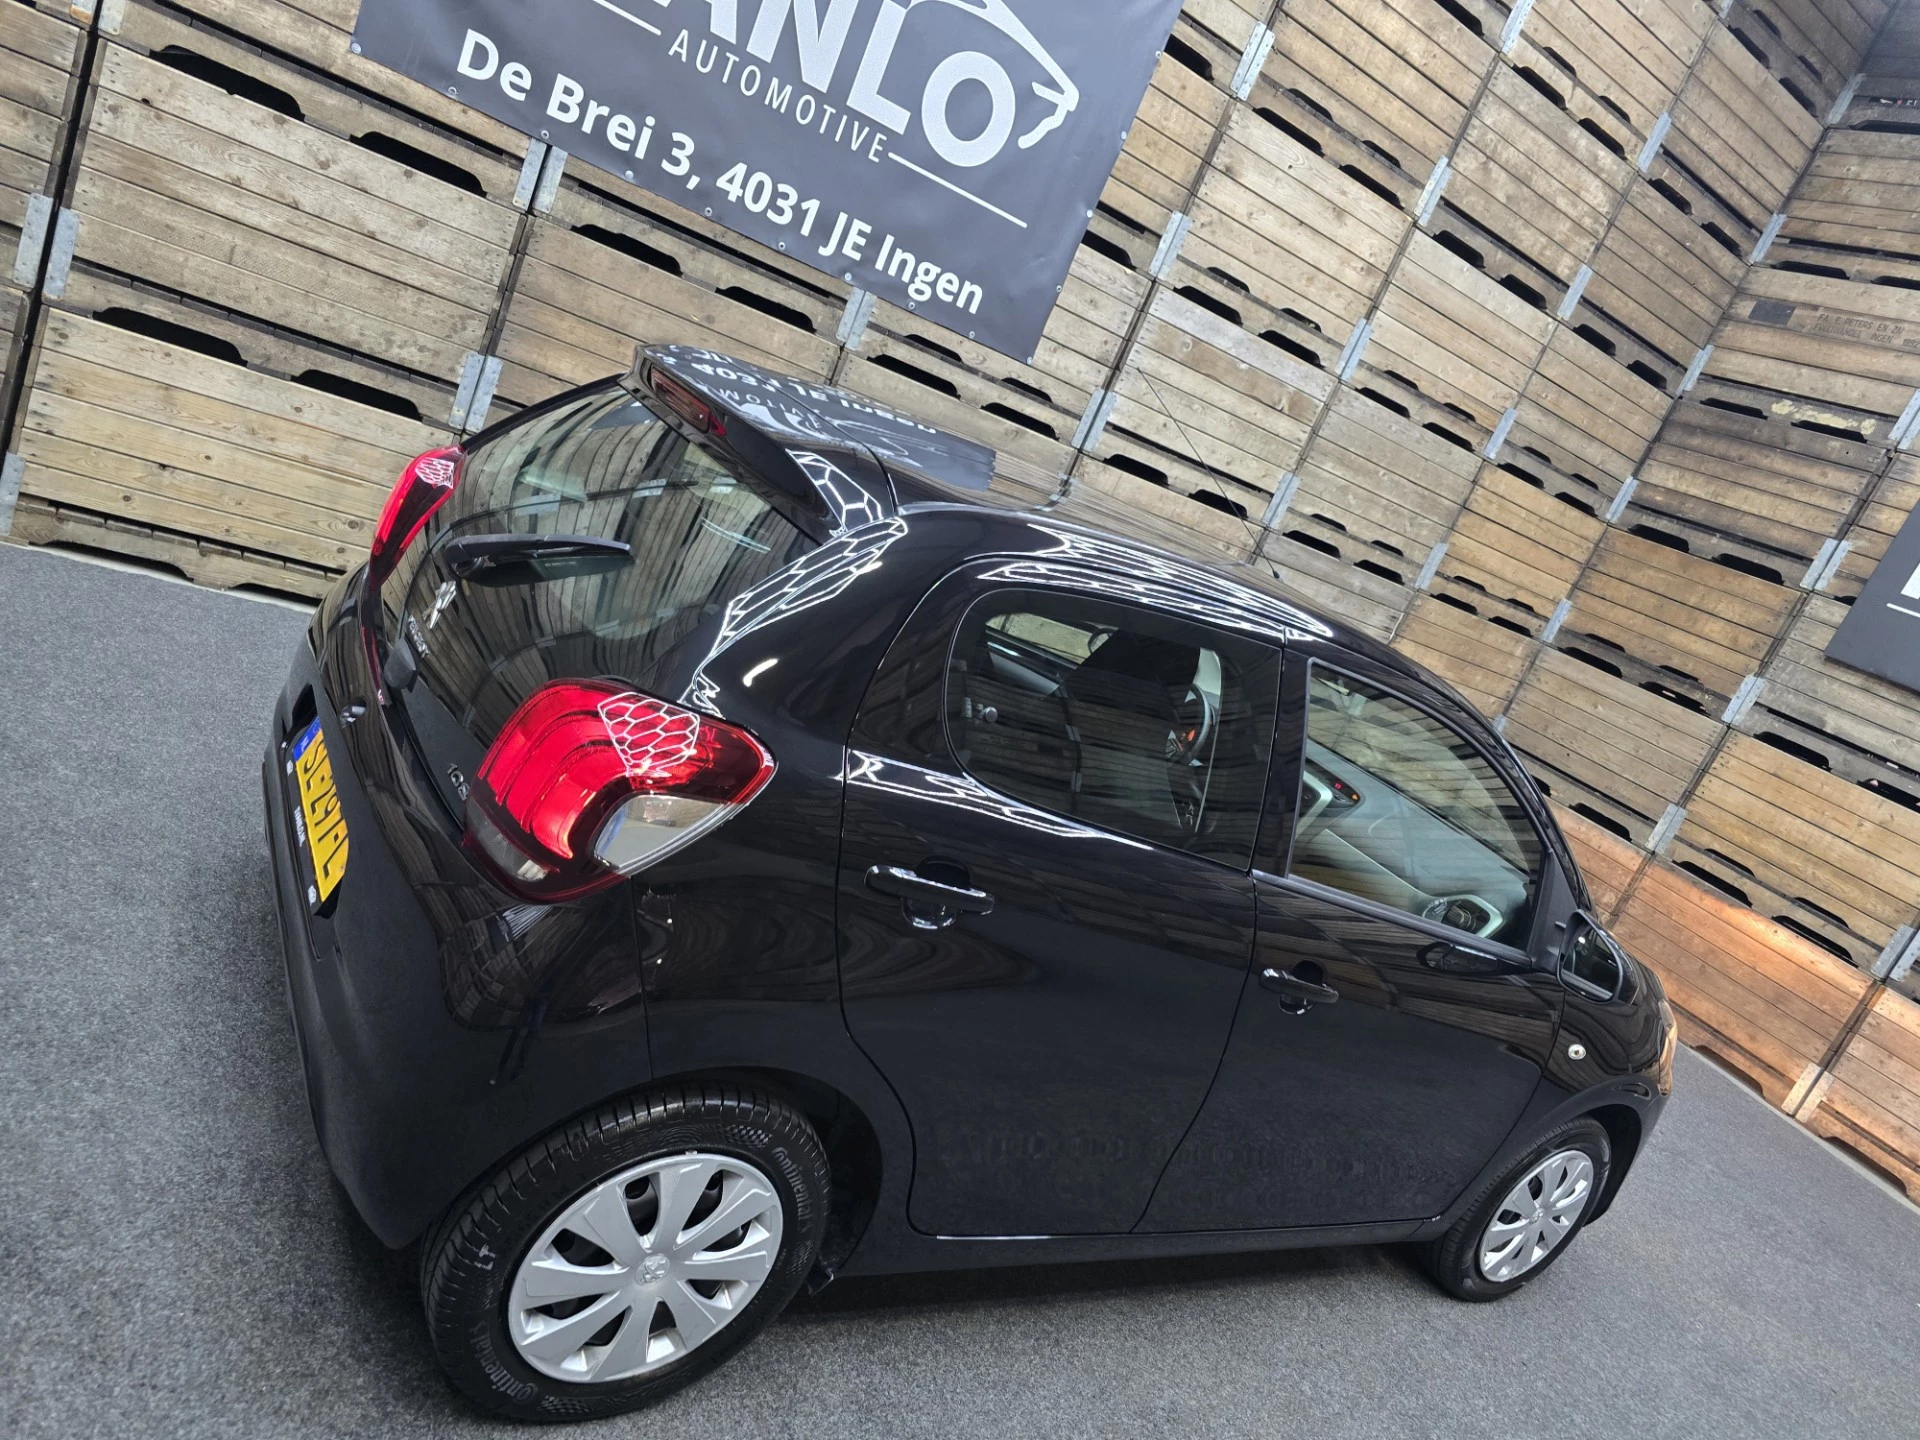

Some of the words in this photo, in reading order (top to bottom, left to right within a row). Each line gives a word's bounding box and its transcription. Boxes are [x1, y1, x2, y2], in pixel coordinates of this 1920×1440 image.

[668, 29, 888, 163] AUTOMOTIVE
[456, 28, 532, 101] De
[546, 73, 656, 160] Brei
[661, 131, 700, 190] 3,
[716, 162, 821, 237] 4031
[817, 211, 872, 262] JE
[874, 233, 983, 315] Ingen
[447, 762, 469, 800] 108
[771, 1147, 813, 1221] Continental
